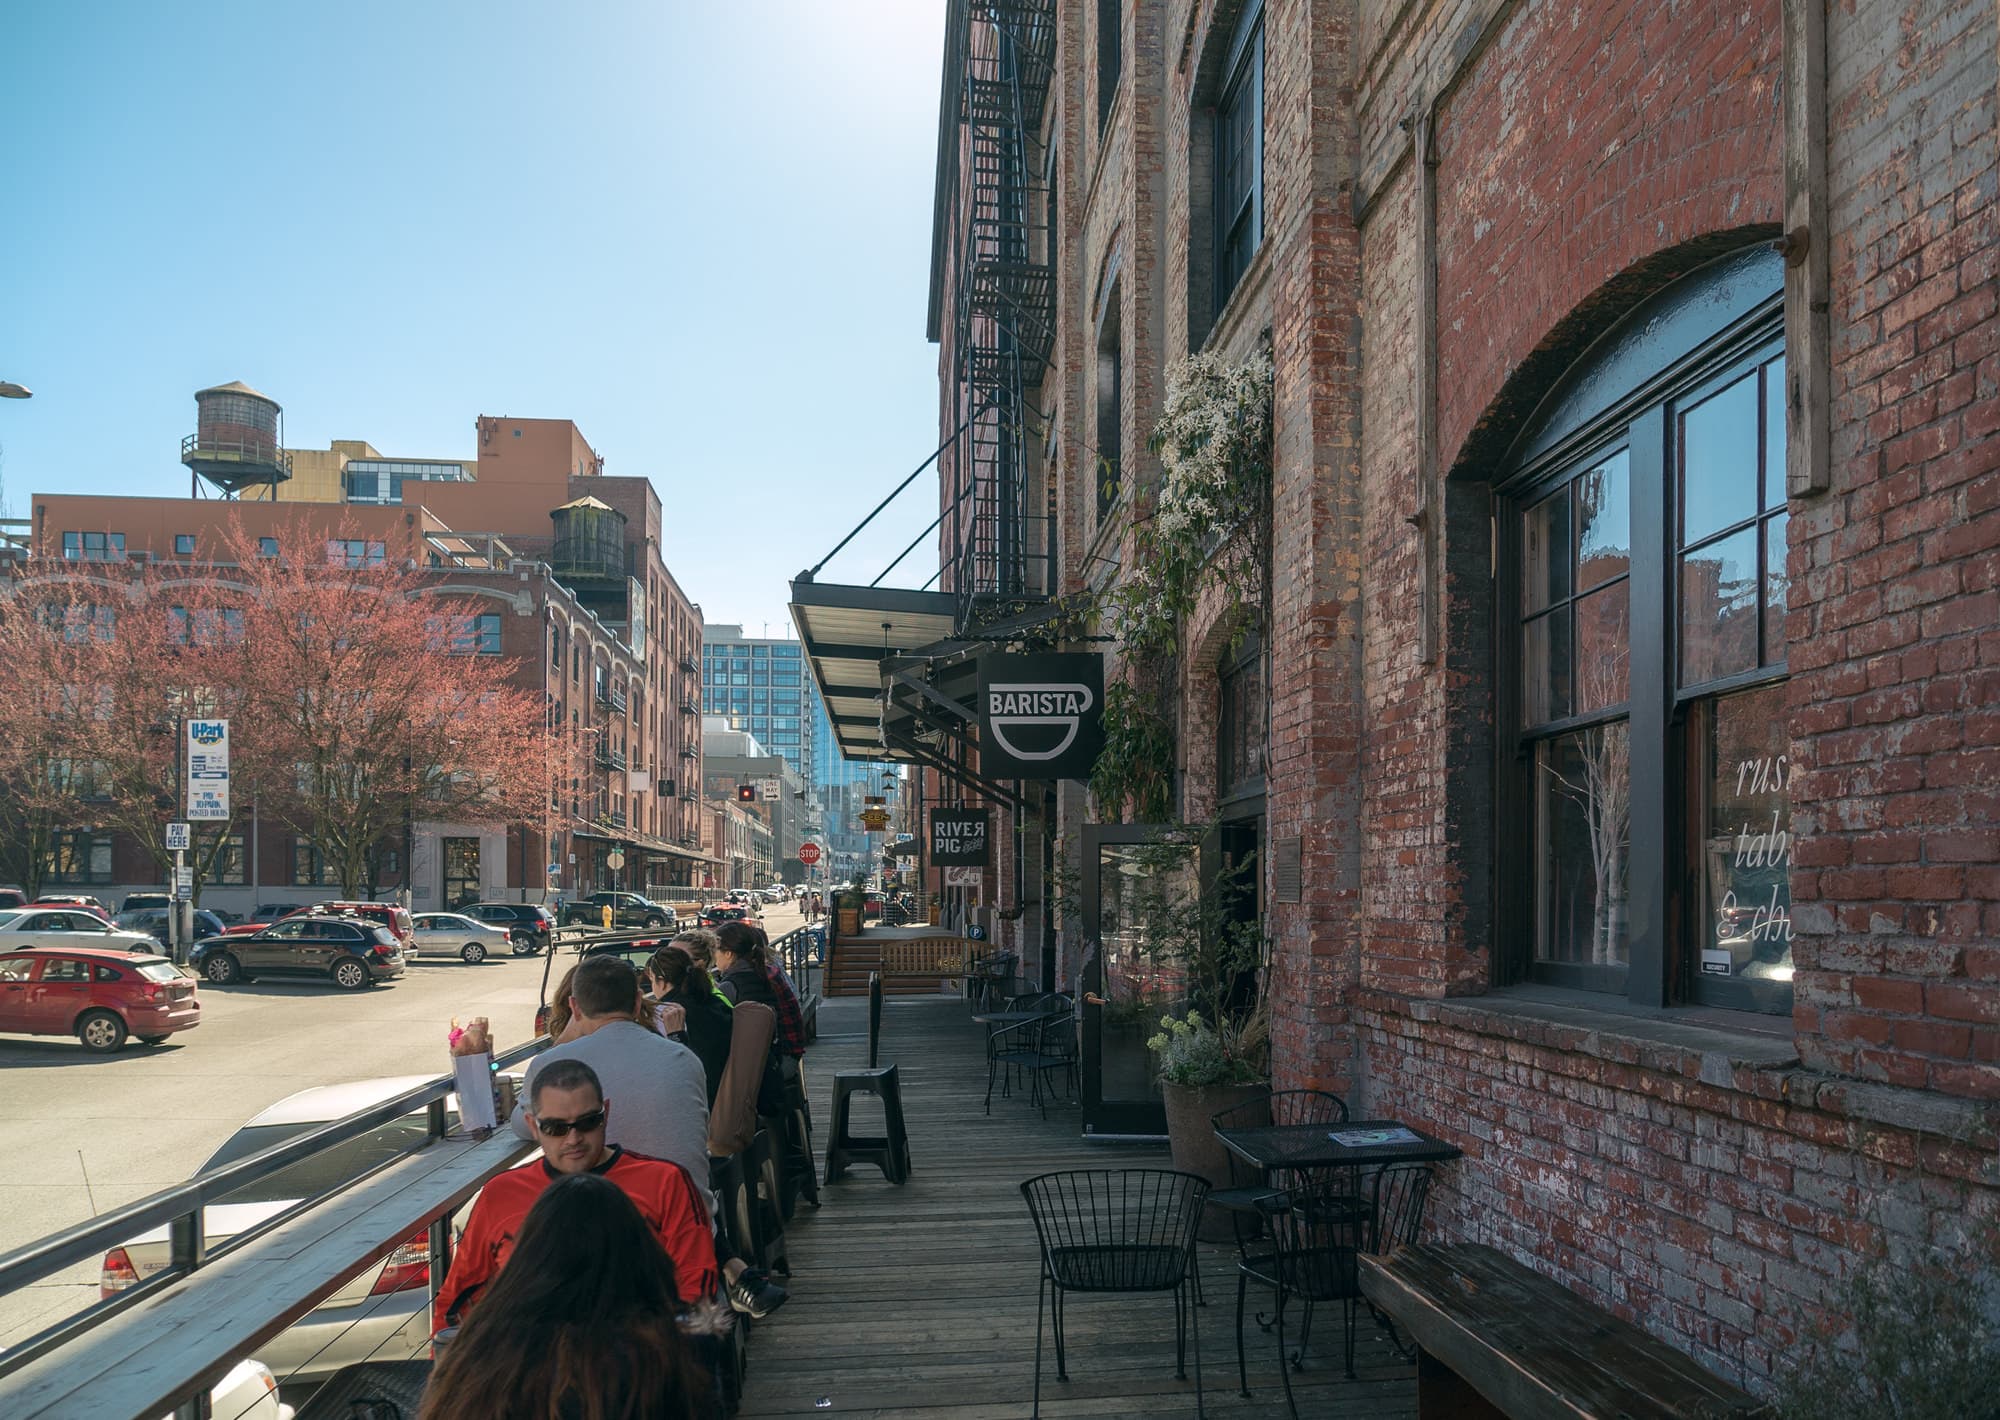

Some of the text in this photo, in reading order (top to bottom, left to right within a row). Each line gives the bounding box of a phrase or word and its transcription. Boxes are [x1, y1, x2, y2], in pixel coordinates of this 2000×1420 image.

[989, 693, 1079, 714] BARISTA
[192, 722, 225, 739] U-Park
[203, 792, 214, 800] PAY
[171, 825, 184, 836] PAY
[935, 821, 985, 837] RIVER
[167, 836, 188, 848] HERE
[935, 838, 961, 854] PIG
[800, 849, 820, 858] STOP
